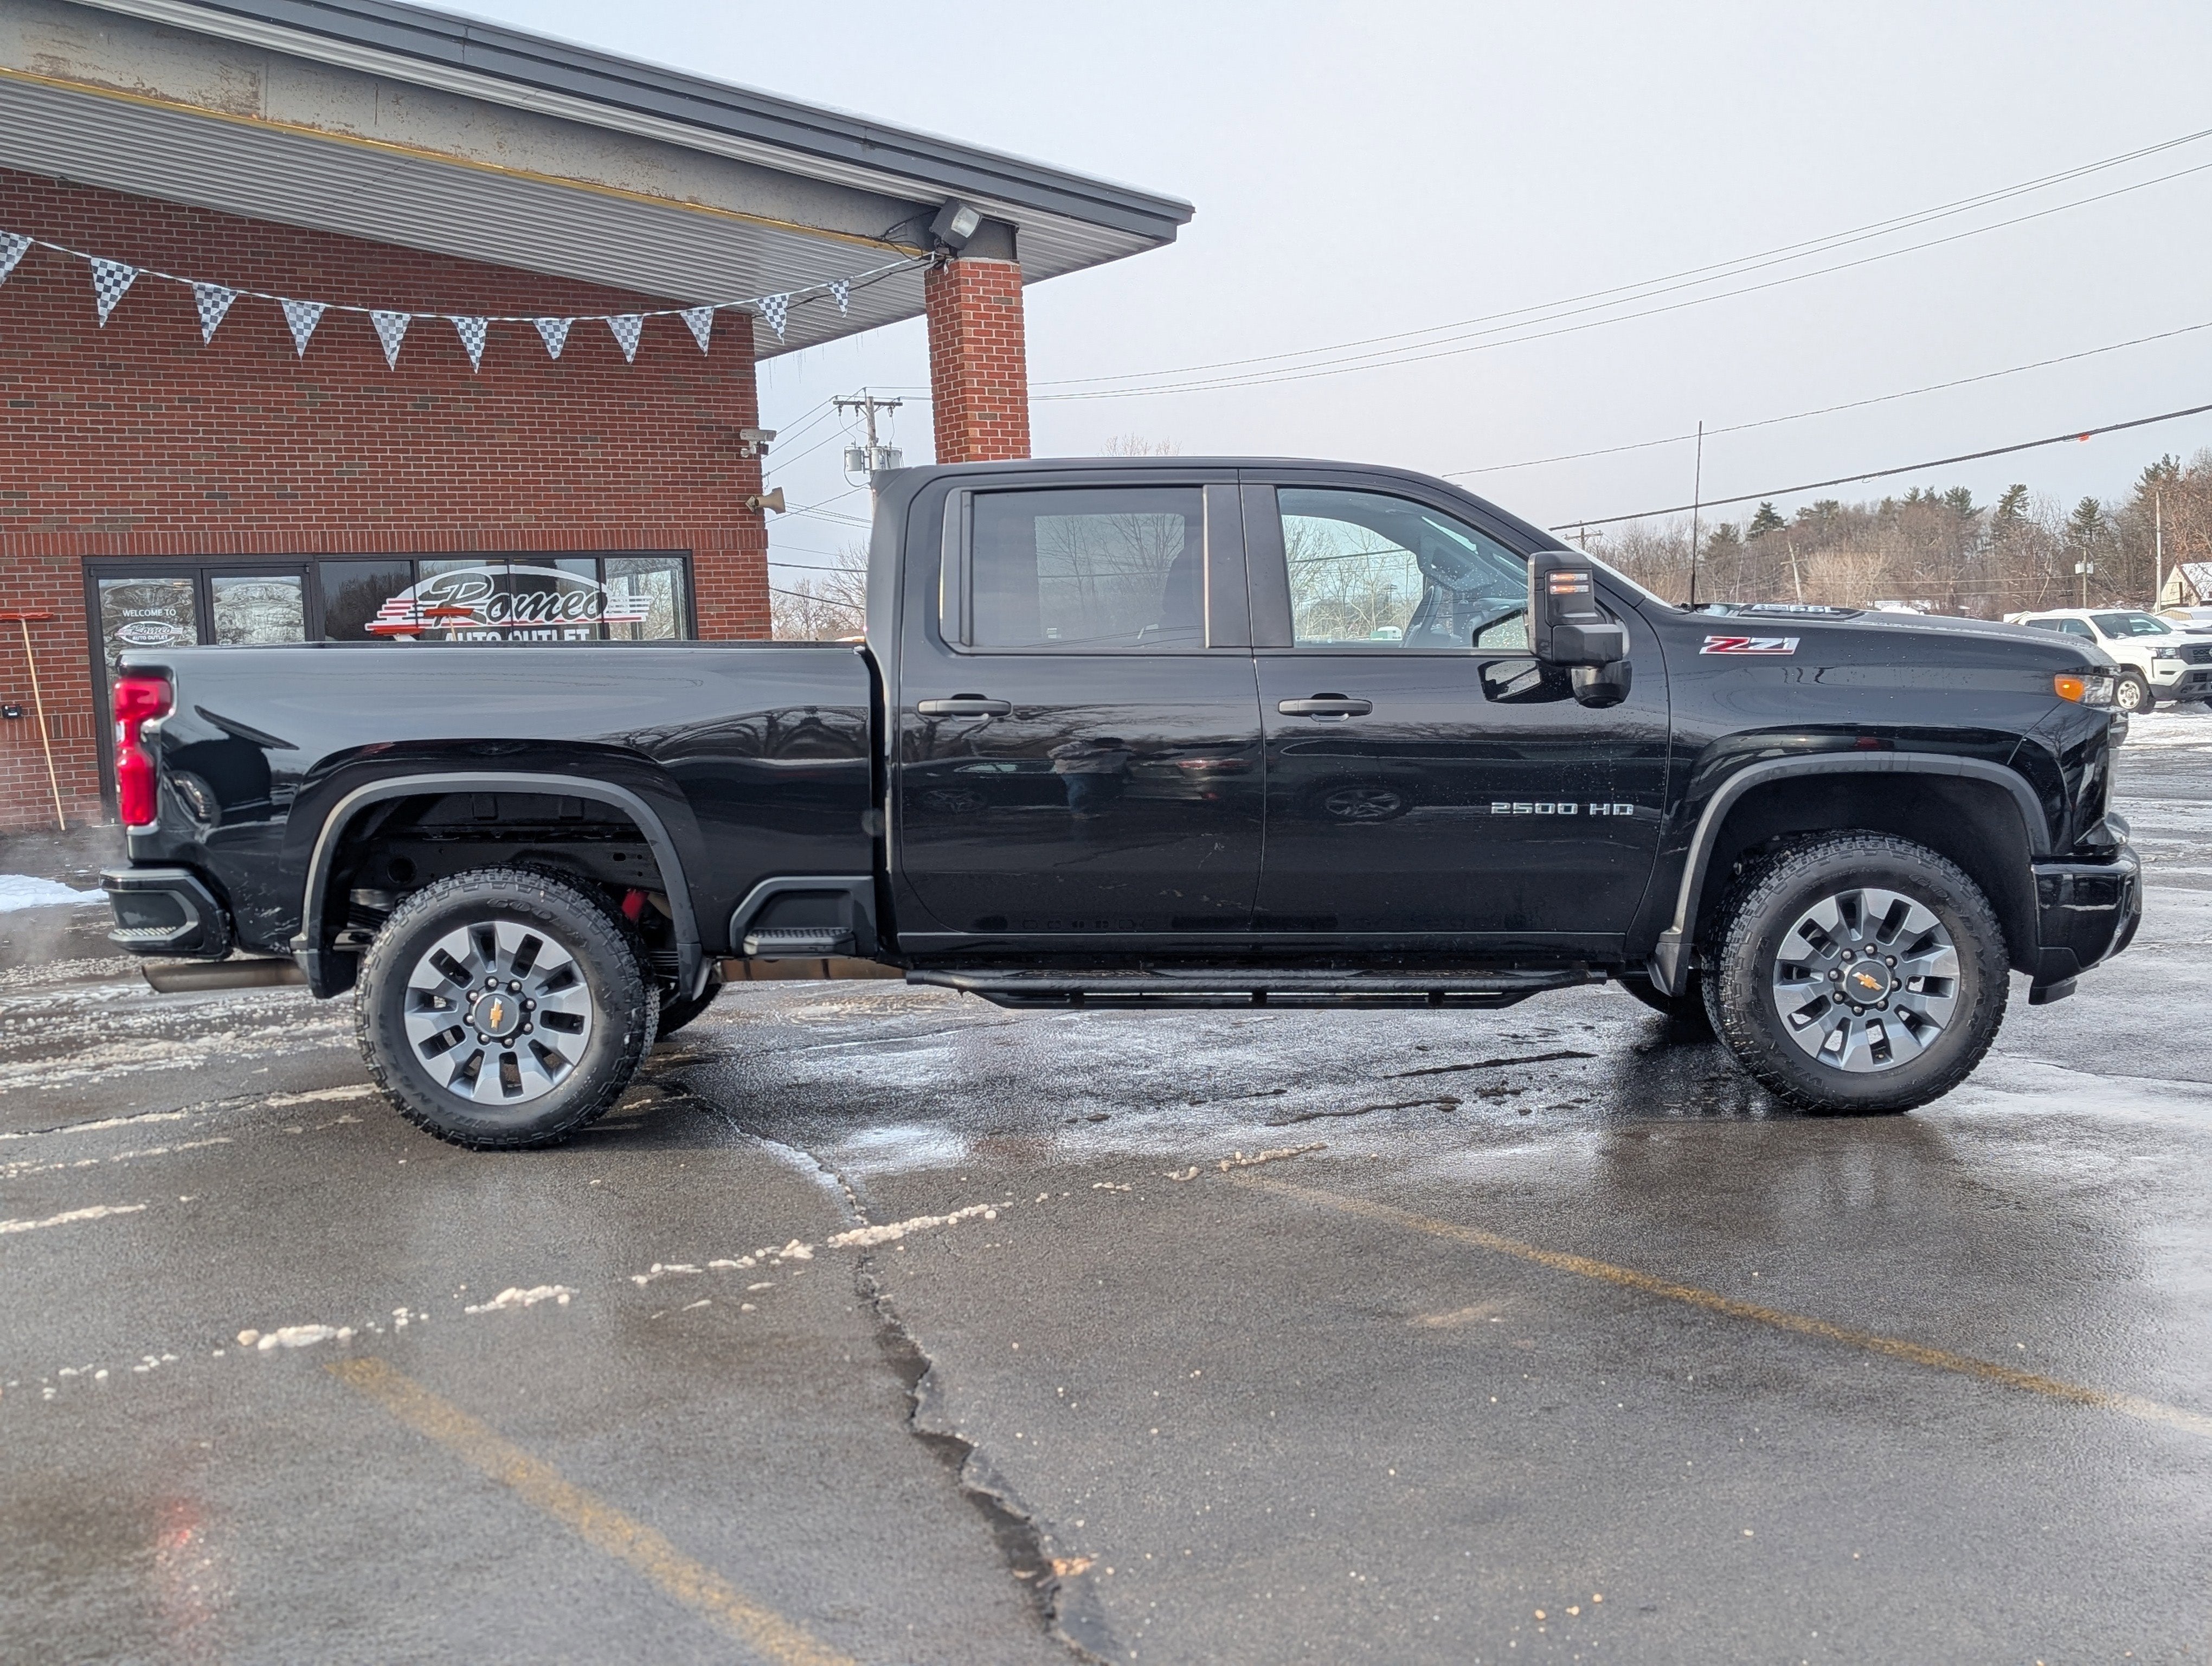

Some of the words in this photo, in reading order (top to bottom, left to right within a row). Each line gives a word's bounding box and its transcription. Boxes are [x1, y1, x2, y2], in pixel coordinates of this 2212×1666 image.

[430, 572, 607, 628] Romeo
[130, 623, 172, 634] Romeo
[1699, 636, 1801, 655] Z71
[1491, 803, 1578, 814] 2500
[1590, 803, 1634, 815] HD
